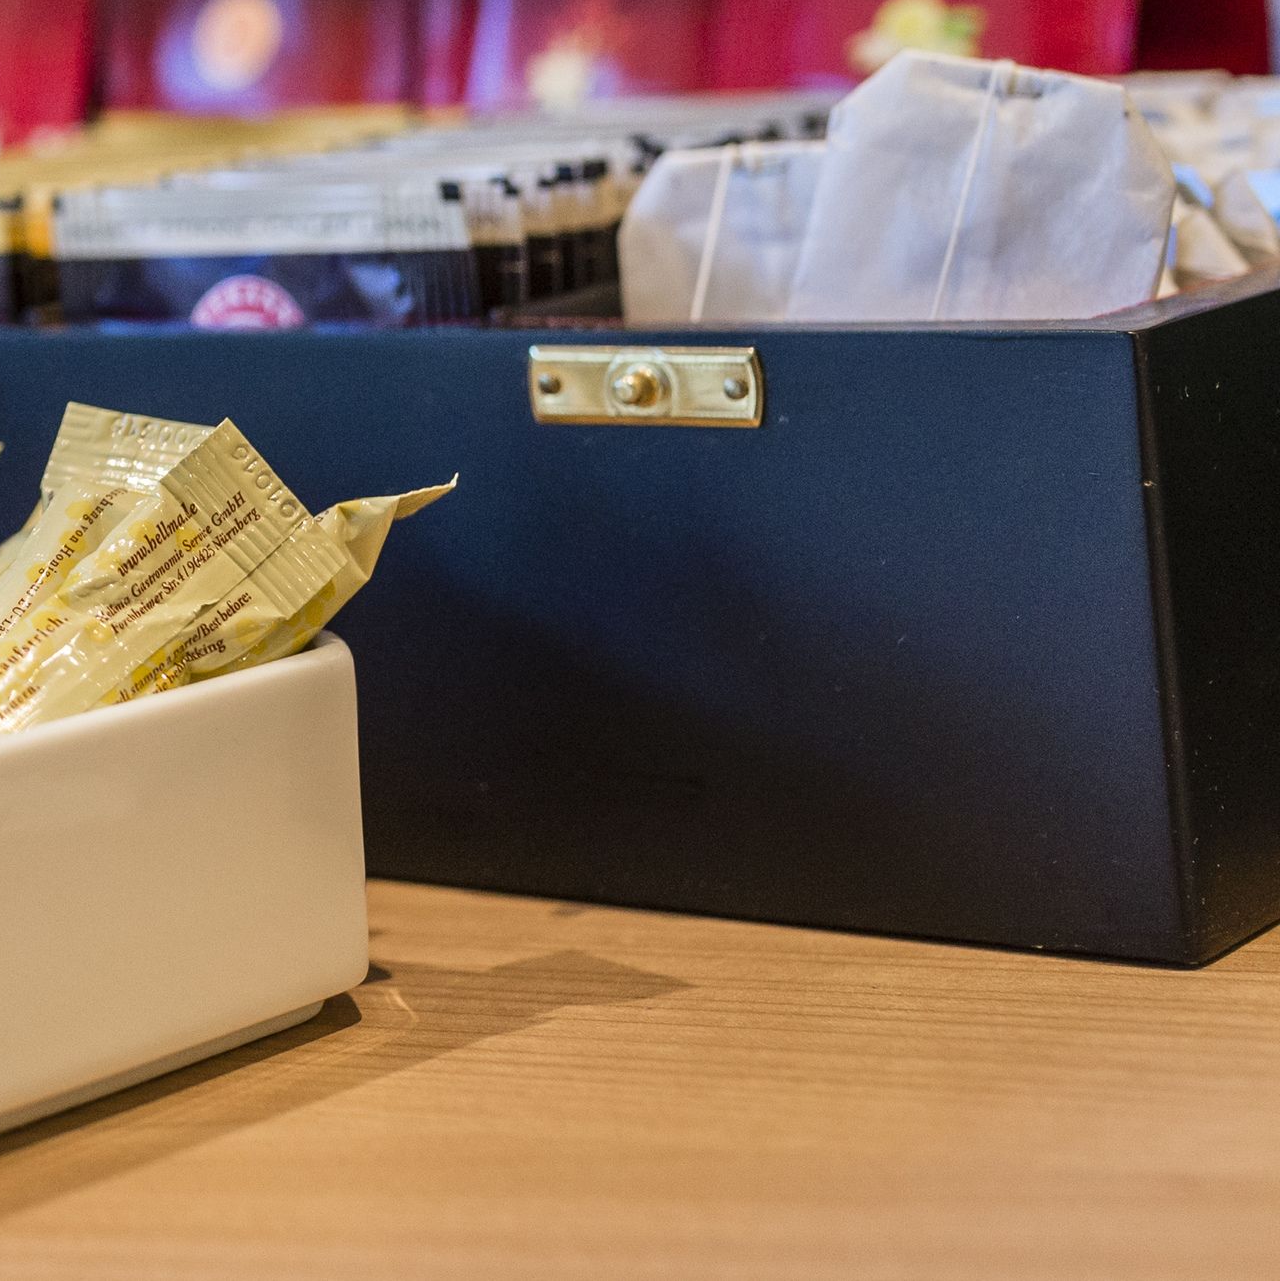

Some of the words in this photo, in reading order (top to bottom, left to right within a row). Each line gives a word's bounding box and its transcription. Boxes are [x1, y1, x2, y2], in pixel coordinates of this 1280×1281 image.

[68, 522, 89, 545] von
[210, 506, 262, 550] Nürnberg
[37, 544, 74, 578] Honig
[127, 543, 185, 599] Gastronomie
[216, 590, 253, 622] before:
